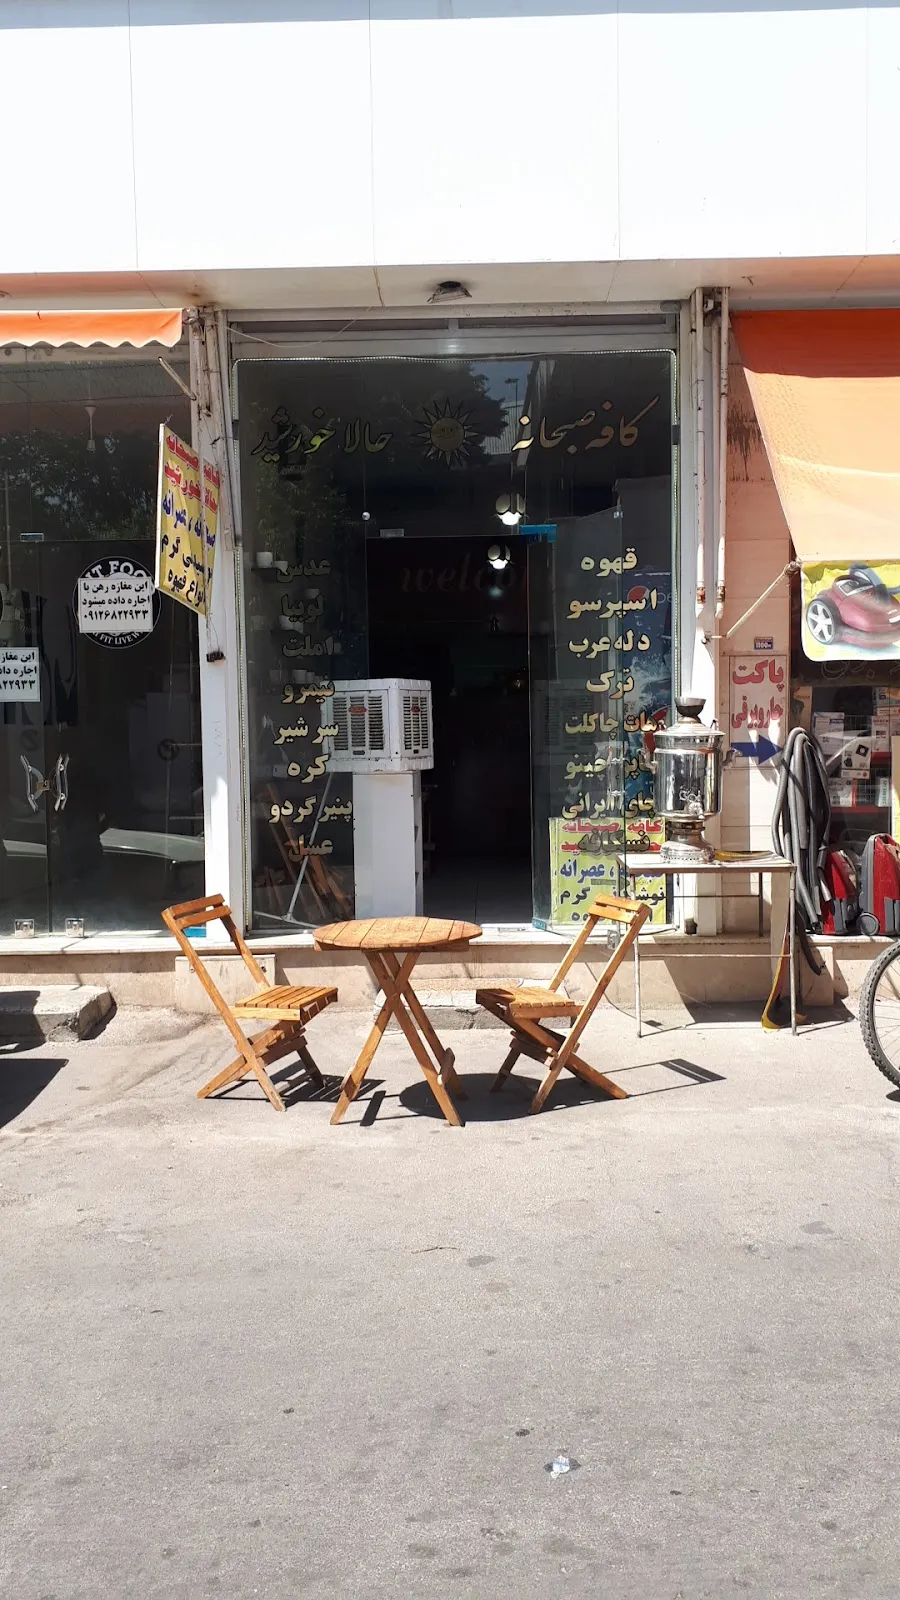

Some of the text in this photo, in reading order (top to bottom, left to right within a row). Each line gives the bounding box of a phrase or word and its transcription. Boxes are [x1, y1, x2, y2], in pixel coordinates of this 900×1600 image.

[251, 395, 659, 463] کافه صبحانه حالا خورشید
[277, 560, 330, 583] عدس
[581, 546, 637, 577] قهوه
[92, 583, 109, 594] رهن
[110, 581, 132, 593] مغازه
[134, 581, 148, 592] این
[82, 595, 150, 608] اجاره داده میشود
[281, 593, 323, 623] لوبیا
[566, 588, 658, 620] اسپرسو
[100, 634, 114, 644] FIT
[115, 635, 133, 645] LIVE
[282, 634, 334, 657] املت
[568, 636, 611, 660] عرب
[0, 651, 35, 664] این مغاز
[13, 665, 37, 678] اجاره
[585, 667, 635, 700] ترک
[732, 659, 785, 692] پاکت
[281, 674, 336, 705] نیمرو
[565, 712, 621, 740] چاکلت
[287, 755, 330, 783] کره
[269, 795, 317, 823] گردو
[319, 797, 351, 823] پنیر
[288, 835, 334, 862] عسل
[560, 859, 605, 883] عصرانه
[560, 887, 591, 904] گرم
